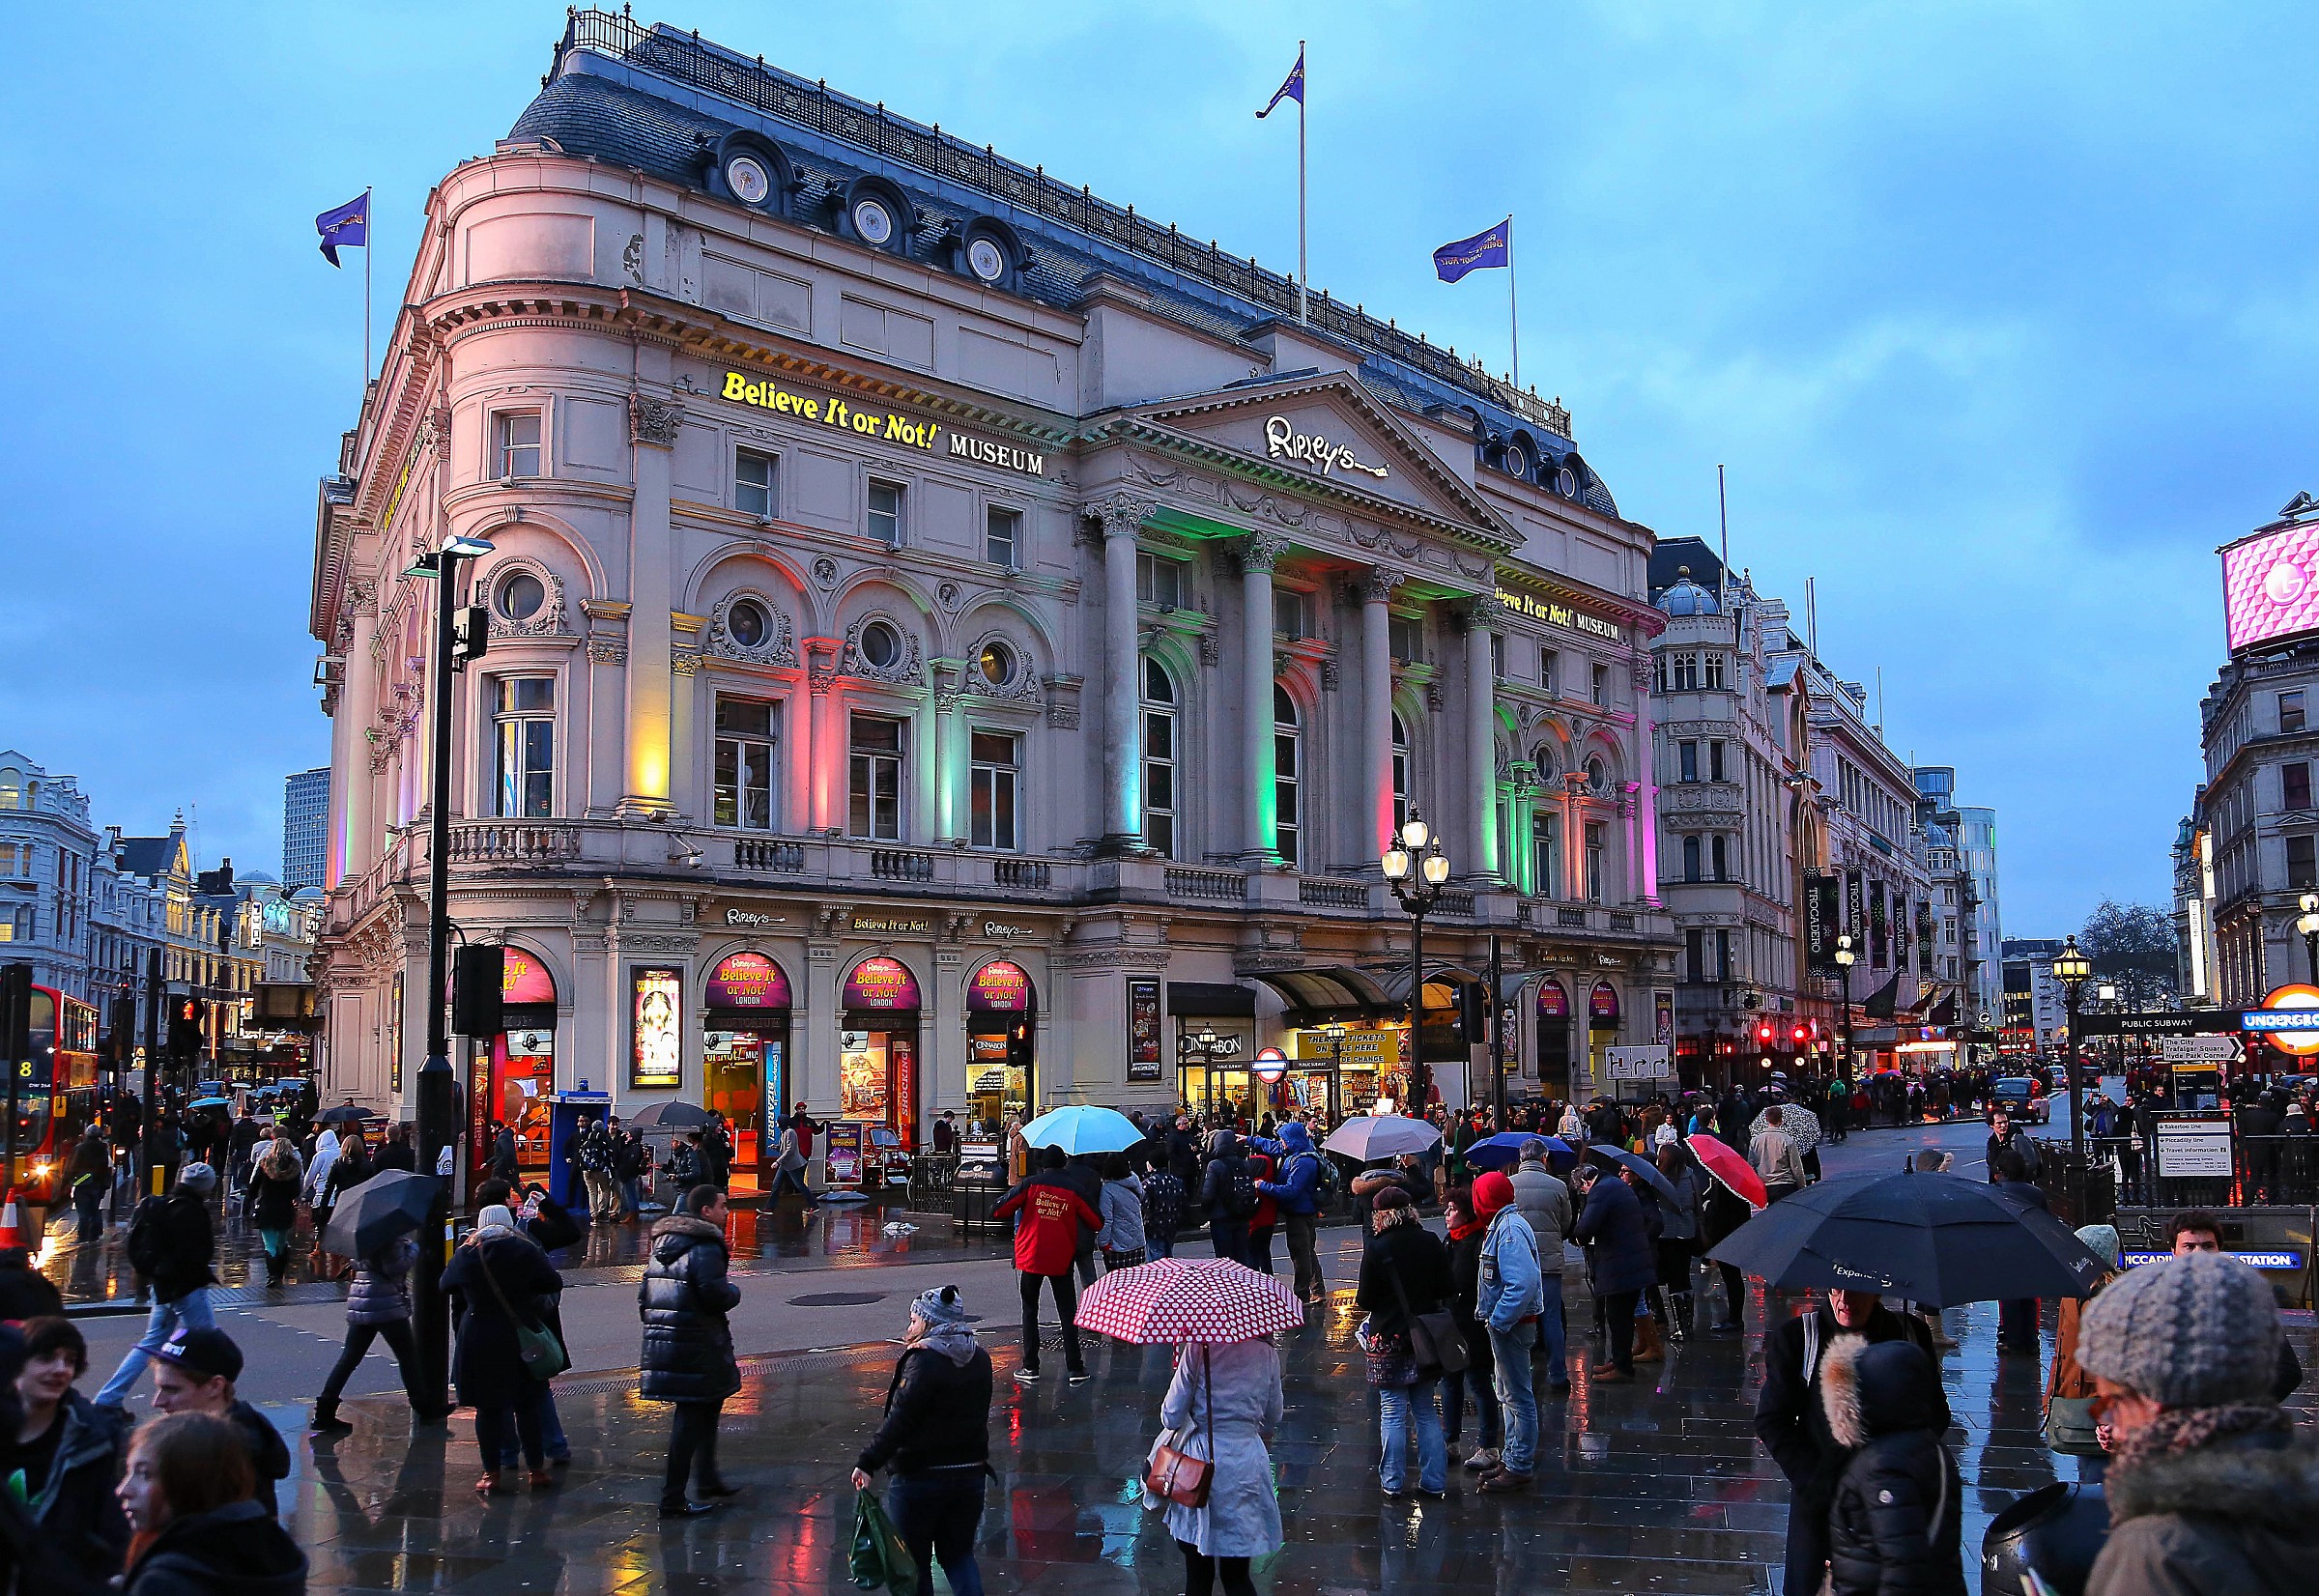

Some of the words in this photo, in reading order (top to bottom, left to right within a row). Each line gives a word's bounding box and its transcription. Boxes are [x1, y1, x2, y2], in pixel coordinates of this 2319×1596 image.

[721, 371, 818, 419] Believe
[824, 397, 848, 427] It
[852, 412, 881, 435] or
[882, 413, 938, 450] Not!
[950, 433, 1045, 475] MUSEUM
[1266, 415, 1389, 477] Ripley's
[1523, 594, 1534, 615] It
[1535, 604, 1547, 619] or
[1549, 604, 1572, 627] Not!
[1577, 613, 1618, 640] MUSEUM
[1850, 882, 1860, 940] TROCADERO
[728, 908, 786, 927] Ripley's
[1809, 888, 1821, 953] TROCADERO
[854, 919, 886, 929] Believe
[888, 919, 897, 930] It
[899, 922, 908, 930] or
[910, 920, 929, 931] Not!
[1896, 906, 1905, 955] TROCADERO
[512, 961, 528, 975] It
[720, 968, 761, 982] Believe
[764, 969, 775, 983] It
[856, 972, 894, 984] Believe
[896, 973, 907, 985] It
[978, 976, 1013, 987] Believe
[1015, 976, 1024, 987] It
[727, 985, 740, 995] or
[742, 983, 767, 995] Not!
[862, 988, 874, 997] or
[876, 985, 900, 998] Not!
[996, 988, 1017, 1000] Not!
[735, 996, 760, 1005] LONDON
[870, 998, 893, 1007] LONDON
[2155, 1018, 2193, 1027] SUBWAY
[1349, 1034, 1386, 1042] TICKETS
[1331, 1044, 1352, 1053] SLE
[1035, 1198, 1060, 1208] Believe
[1046, 1208, 1063, 1217] Not!
[2239, 1255, 2290, 1266] STATION
